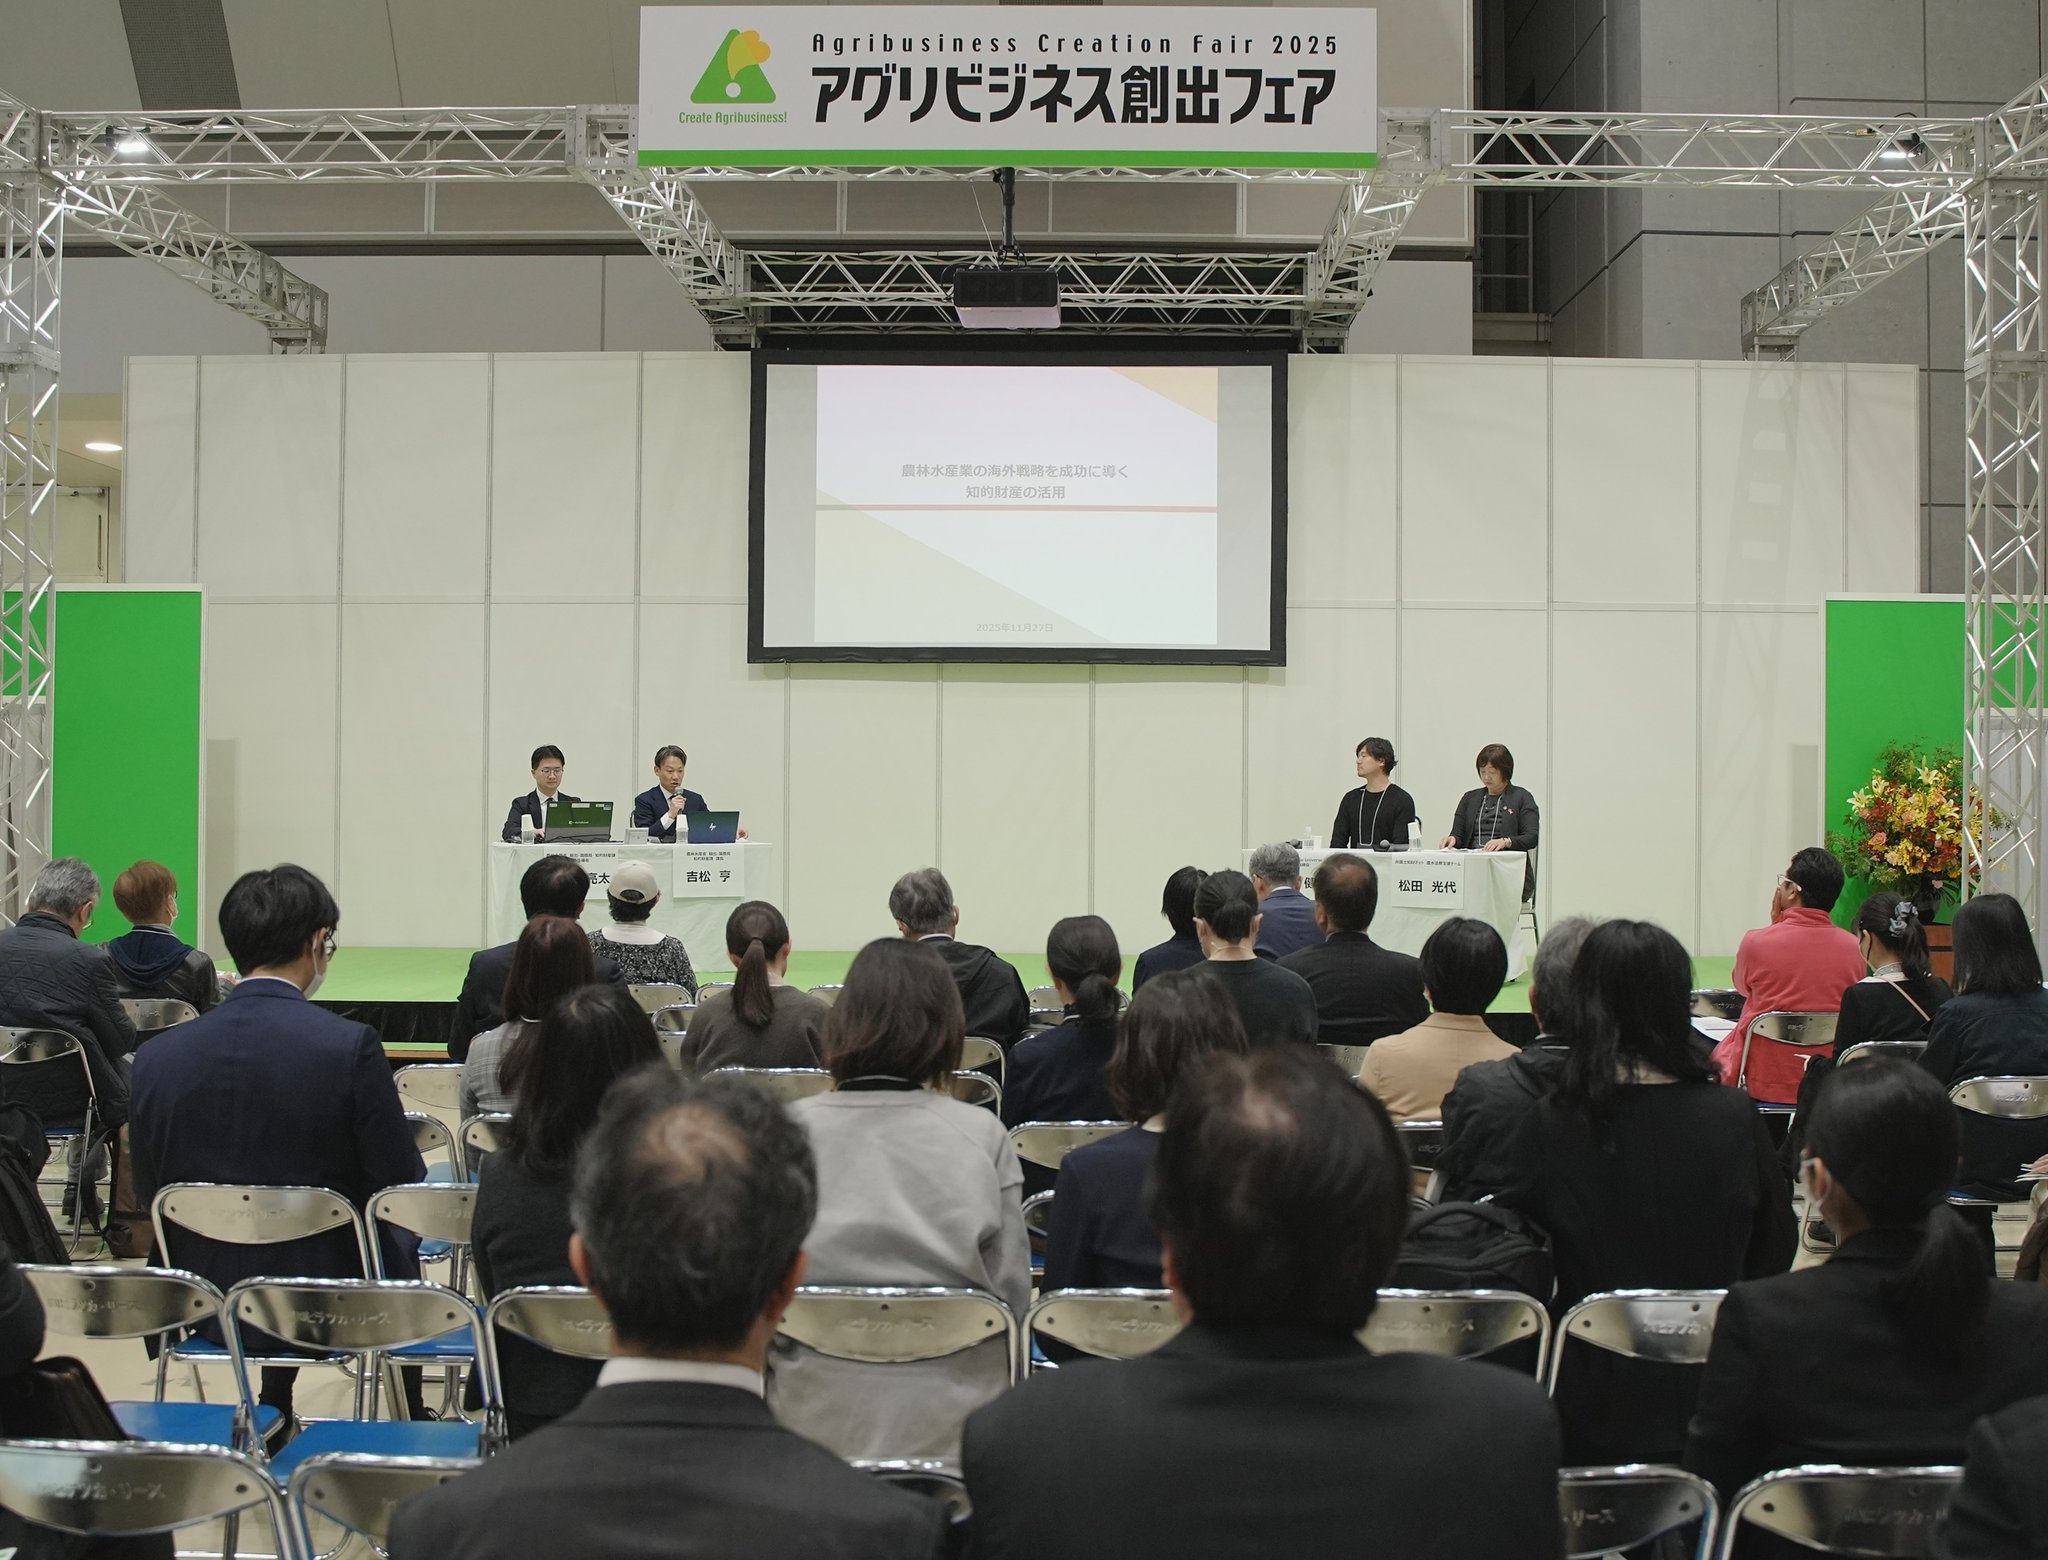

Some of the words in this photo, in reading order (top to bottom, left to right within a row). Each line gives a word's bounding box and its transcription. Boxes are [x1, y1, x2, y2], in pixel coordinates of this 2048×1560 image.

[811, 33, 1017, 55] Agribusiness
[1037, 34, 1171, 53] Creation
[1193, 34, 1253, 53] Fair
[1272, 35, 1337, 55] 2025
[811, 63, 1336, 125] アグリビジネス創出フェア
[678, 111, 713, 124] Create
[715, 111, 788, 125] Agribusiness!
[901, 463, 1129, 478] 農林水産業の海外戦略を成功に導く
[965, 485, 1066, 499] 知的財産の活用
[975, 623, 1054, 633] 2025年11月27日
[686, 870, 711, 883] 吉松
[1398, 879, 1423, 893] 松田
[1431, 880, 1457, 894] 光代
